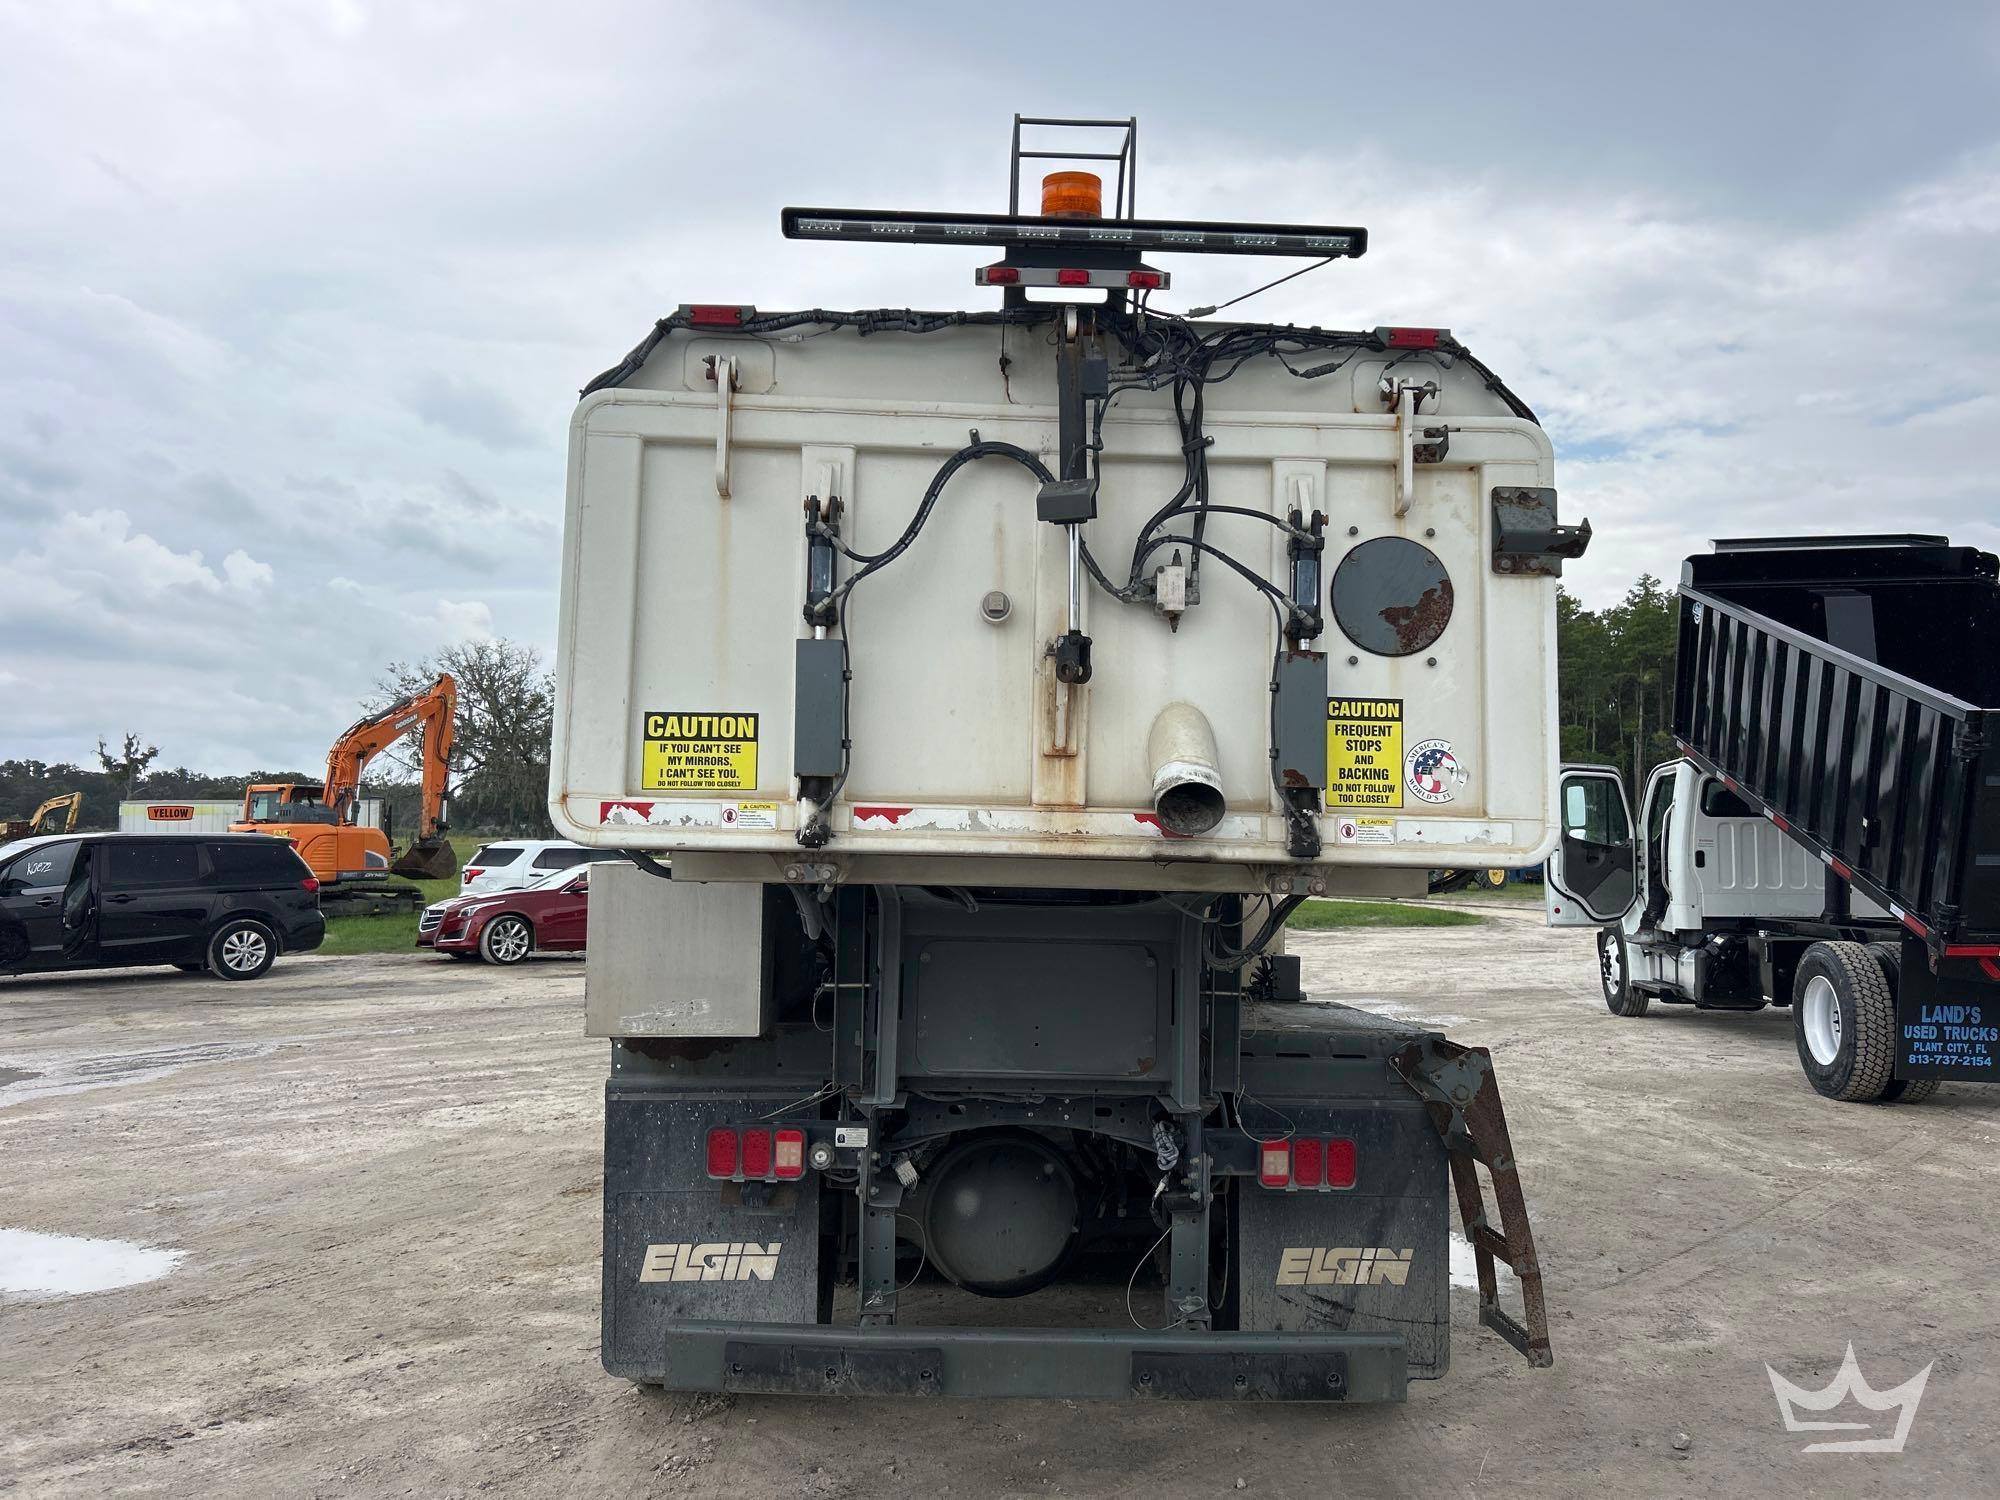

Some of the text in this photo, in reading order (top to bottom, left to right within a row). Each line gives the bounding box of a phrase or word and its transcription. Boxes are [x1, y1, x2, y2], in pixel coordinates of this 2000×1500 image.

[1328, 702, 1400, 718] CAUTION
[648, 716, 754, 738] CAUTION
[1335, 724, 1392, 737] FREQUENT
[660, 744, 741, 754] IF YOU CAN'T SEE
[1346, 740, 1382, 752] STOPS
[1408, 742, 1445, 763] AMERICA'S
[668, 757, 732, 767] MY MIRRORS,
[1354, 755, 1374, 765] AND
[660, 769, 739, 778] I CAN'T SEE YOU.
[1339, 768, 1389, 780] BACKING
[1332, 784, 1396, 793] DO NOT FOLLOW
[1409, 778, 1439, 801] WORLD'S
[1338, 794, 1390, 804] TOO CLOSELY
[154, 809, 188, 818] YELLOW
[1921, 1006, 1982, 1024] LAND'S
[1904, 1025, 1998, 1041] USED TRUCKS
[1914, 1042, 1987, 1054] PLANT CITY, FL
[1908, 1054, 1992, 1066] 813-737-2154
